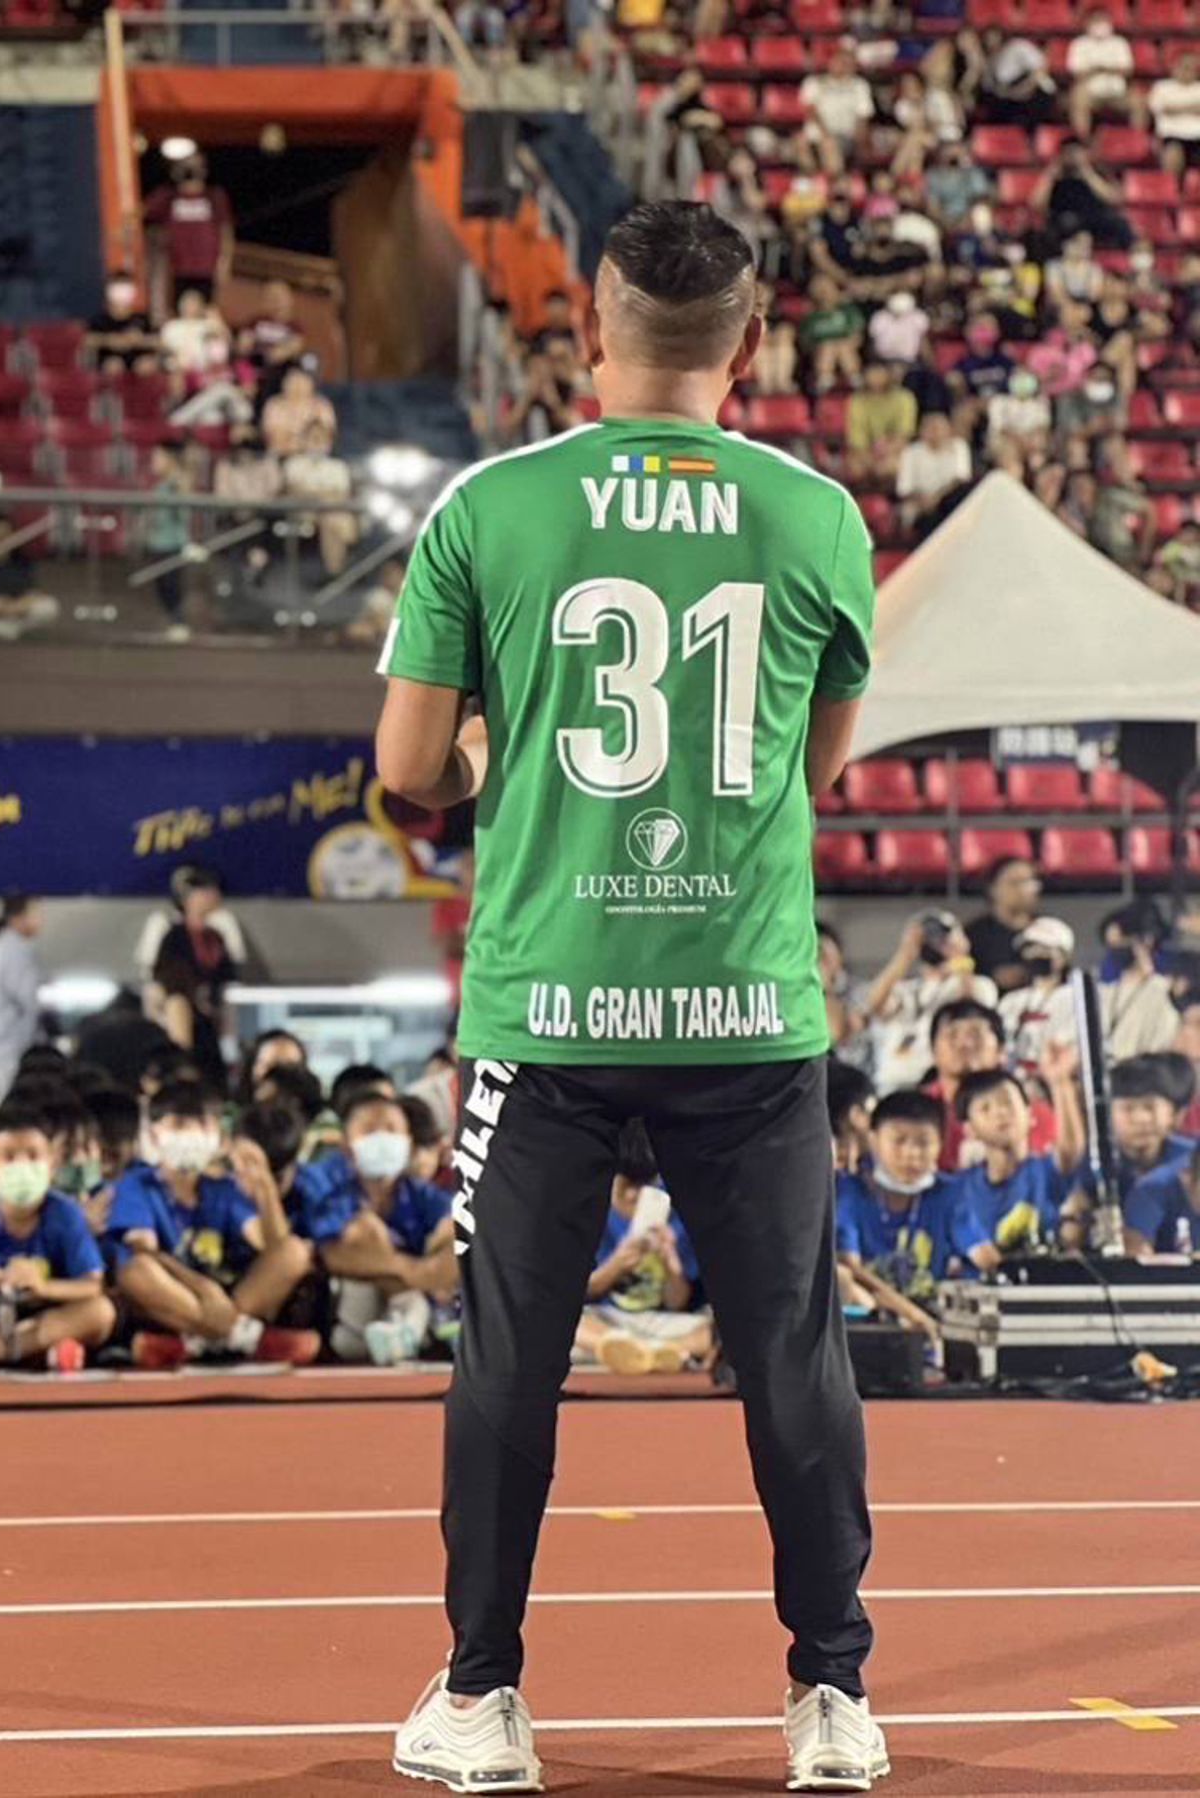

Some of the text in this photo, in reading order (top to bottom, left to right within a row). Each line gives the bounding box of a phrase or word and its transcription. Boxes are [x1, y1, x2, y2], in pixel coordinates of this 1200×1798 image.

[580, 477, 738, 535] YUAN
[552, 577, 765, 798] 31
[575, 874, 737, 898] LUXE DENTAL
[528, 981, 785, 1039] U.D. GRAN TARAJAL
